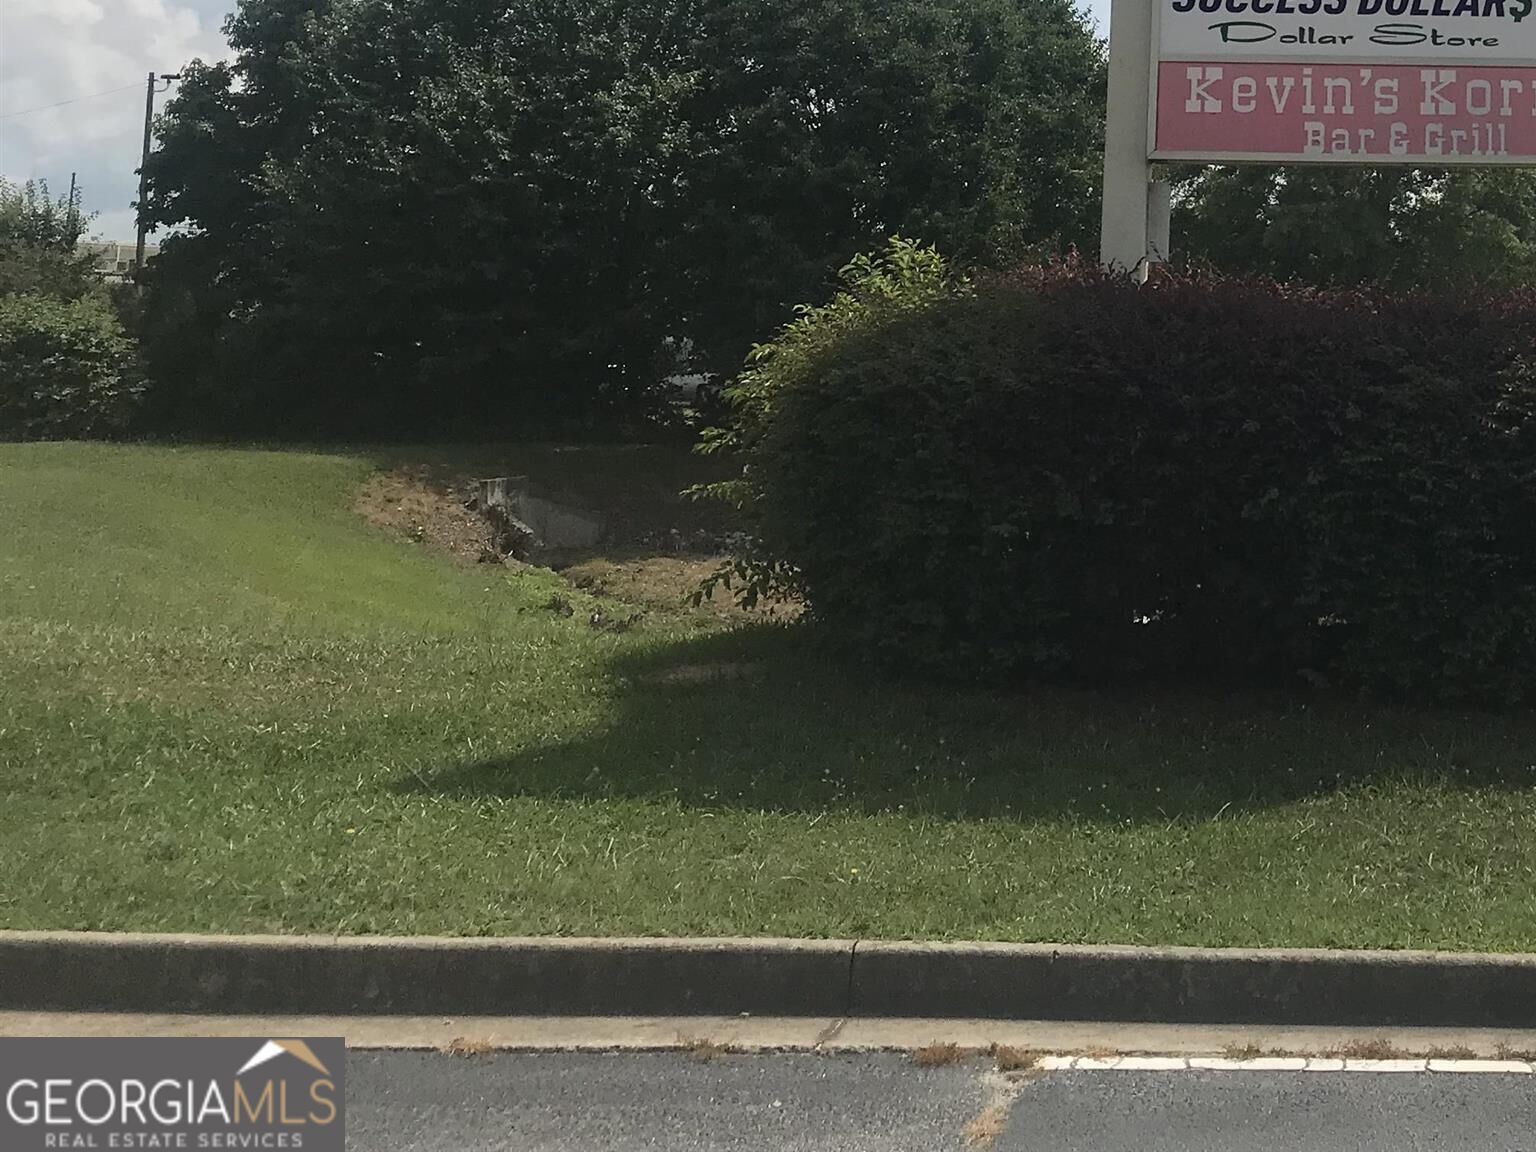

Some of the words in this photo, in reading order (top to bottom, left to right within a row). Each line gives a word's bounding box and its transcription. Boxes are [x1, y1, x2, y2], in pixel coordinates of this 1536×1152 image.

[1208, 21, 1354, 45] Dollar
[1369, 23, 1499, 47] Store
[1185, 66, 1399, 115] Kevin's
[1304, 121, 1375, 156] Bar
[1388, 121, 1410, 156] &
[1424, 123, 1508, 156] Grill
